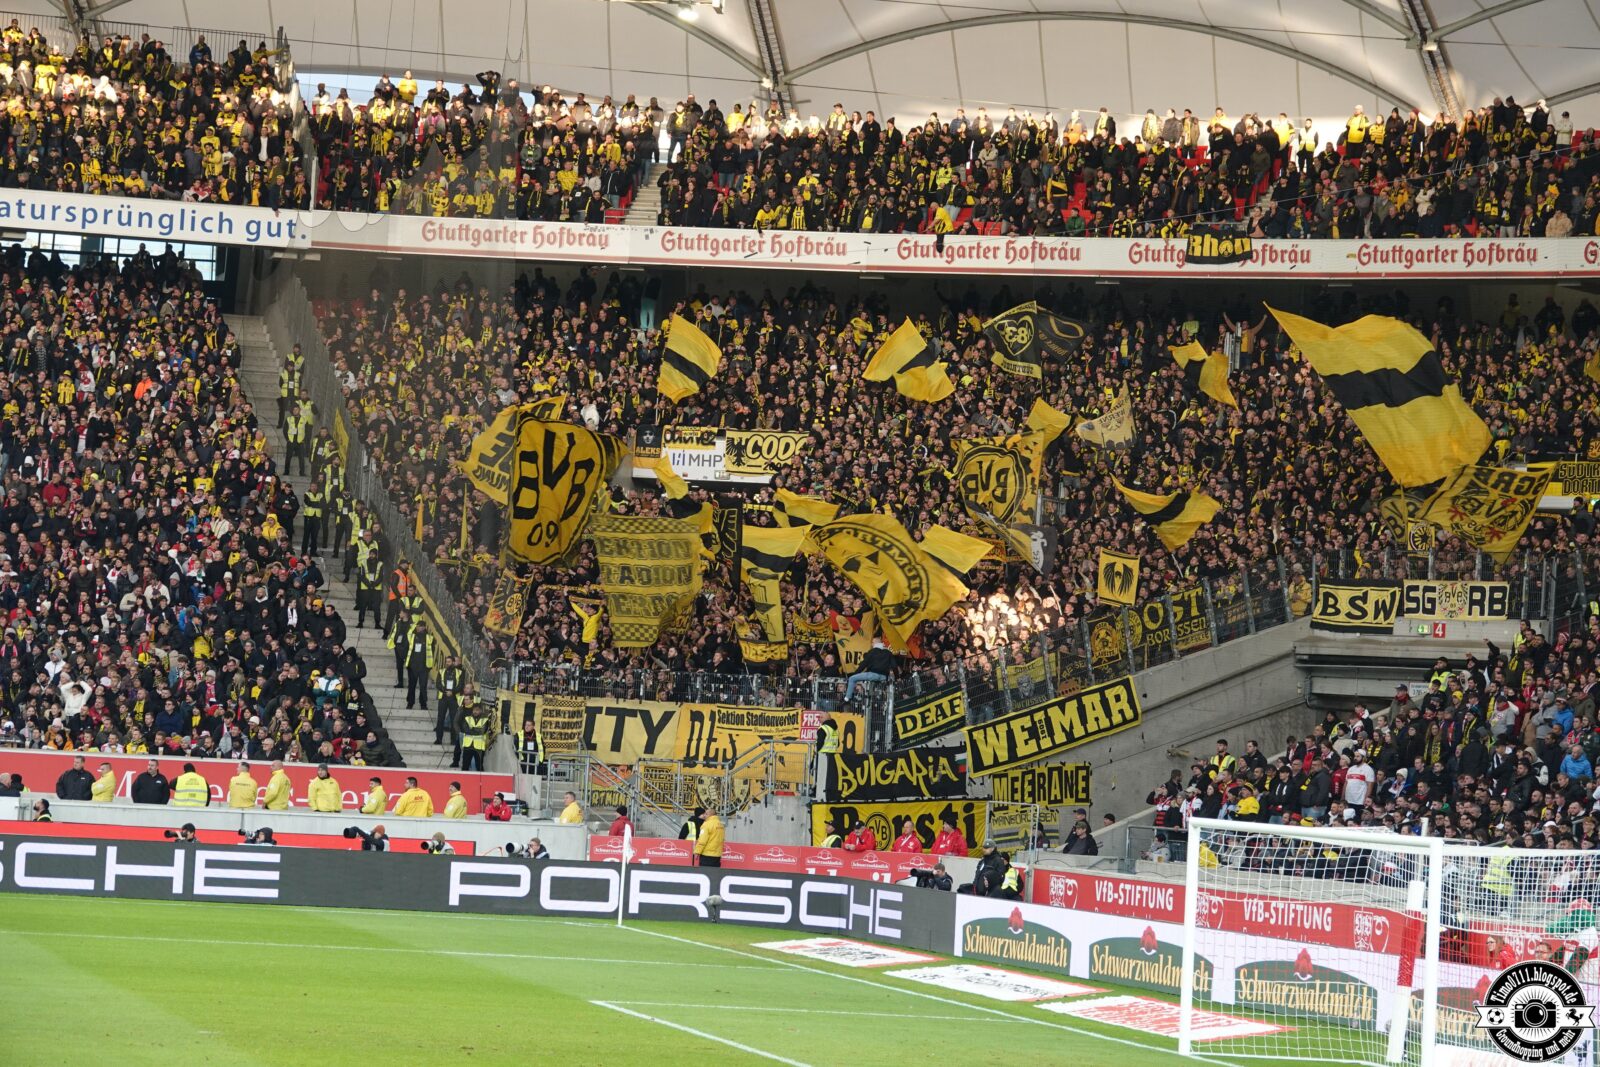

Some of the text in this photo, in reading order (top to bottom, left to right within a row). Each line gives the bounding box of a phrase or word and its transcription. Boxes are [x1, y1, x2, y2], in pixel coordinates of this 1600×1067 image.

[246, 218, 307, 242] gut.
[421, 220, 609, 250] Stuttgarter Hofbräu
[661, 230, 847, 259] Stuttgarter Hofbräu
[897, 238, 1080, 265] Stutgarter Hofbräu
[1128, 241, 1311, 269] Stuttg ofbräu
[1358, 241, 1537, 270] Stuttgarter Hofbräu
[636, 446, 661, 455] ALEKS
[688, 453, 723, 468] MHP
[527, 520, 560, 548] 09
[1143, 586, 1203, 631] OST
[1320, 589, 1398, 622] BSW
[1404, 585, 1437, 615] SG
[1467, 584, 1508, 617] RB
[1435, 625, 1444, 638] 4
[717, 709, 799, 727] Sektion Stadionverbot
[898, 695, 962, 735] DEAF
[972, 684, 1135, 763] WEIMAR
[993, 766, 1087, 809] MEERANE
[0, 842, 281, 899] CHE
[449, 861, 903, 939] PORSCHE
[1095, 880, 1174, 912] VfB-STIFTUNG
[1243, 900, 1333, 933] VfB-STIFTUNG
[964, 924, 1069, 969] Schwarzwaldmilch
[1091, 944, 1209, 993] Schwarzwaldmch
[1239, 967, 1374, 1022] Schwarzwaldmilch
